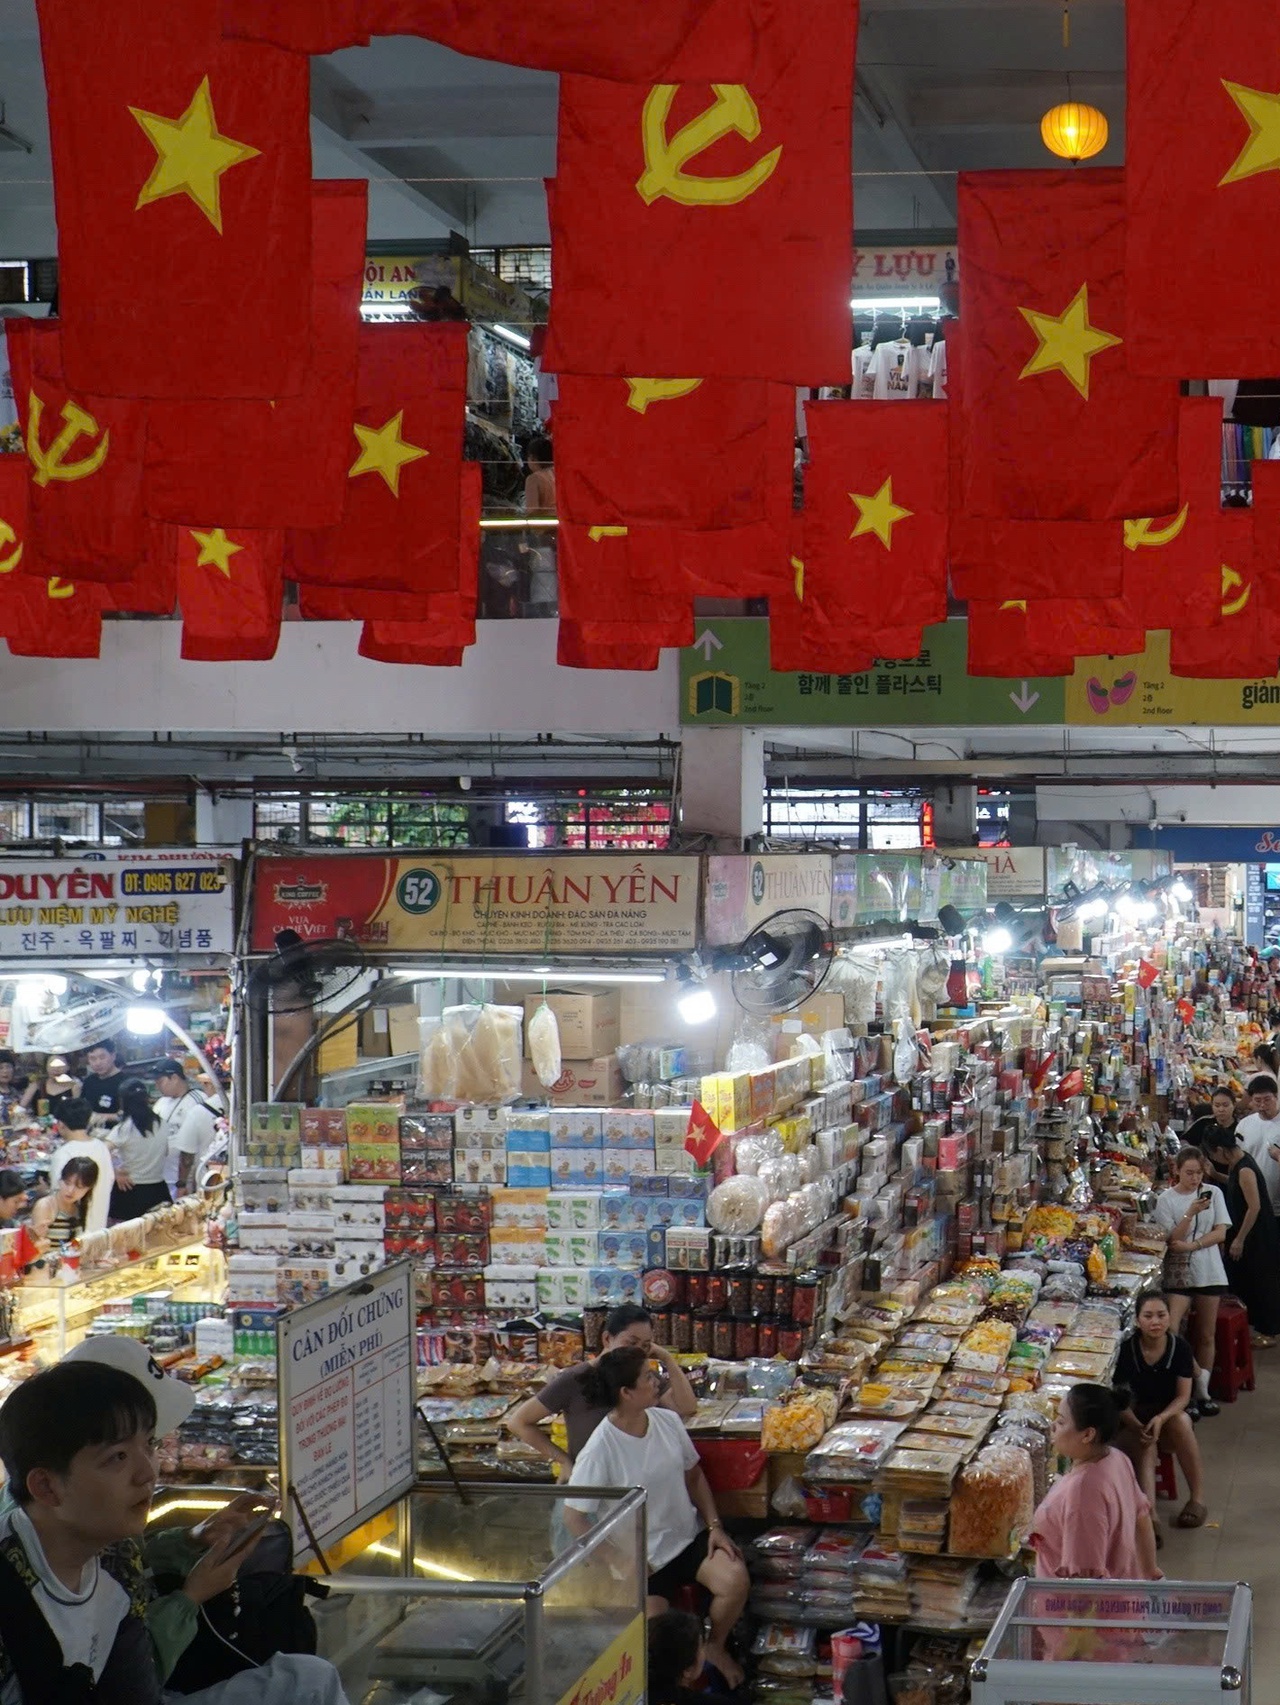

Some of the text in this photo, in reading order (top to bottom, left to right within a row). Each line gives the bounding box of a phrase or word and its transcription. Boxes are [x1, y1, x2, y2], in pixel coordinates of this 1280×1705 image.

[797, 674, 831, 695] 함께
[876, 674, 941, 695] 플라스틱
[1157, 706, 1173, 714] floor
[143, 873, 172, 892] 0905
[175, 872, 196, 891] 627
[405, 877, 433, 905] 52
[445, 863, 682, 910] THUẬN YẾN
[38, 903, 84, 928] NIỆM
[91, 902, 119, 925] MỸ
[126, 901, 180, 927] NGHỆ
[510, 909, 531, 919] KINH
[21, 931, 55, 951] 진주
[292, 1288, 404, 1362] CÂN ĐỐI CHỨNG
[320, 1330, 384, 1379] (MIỄN PHÍ)
